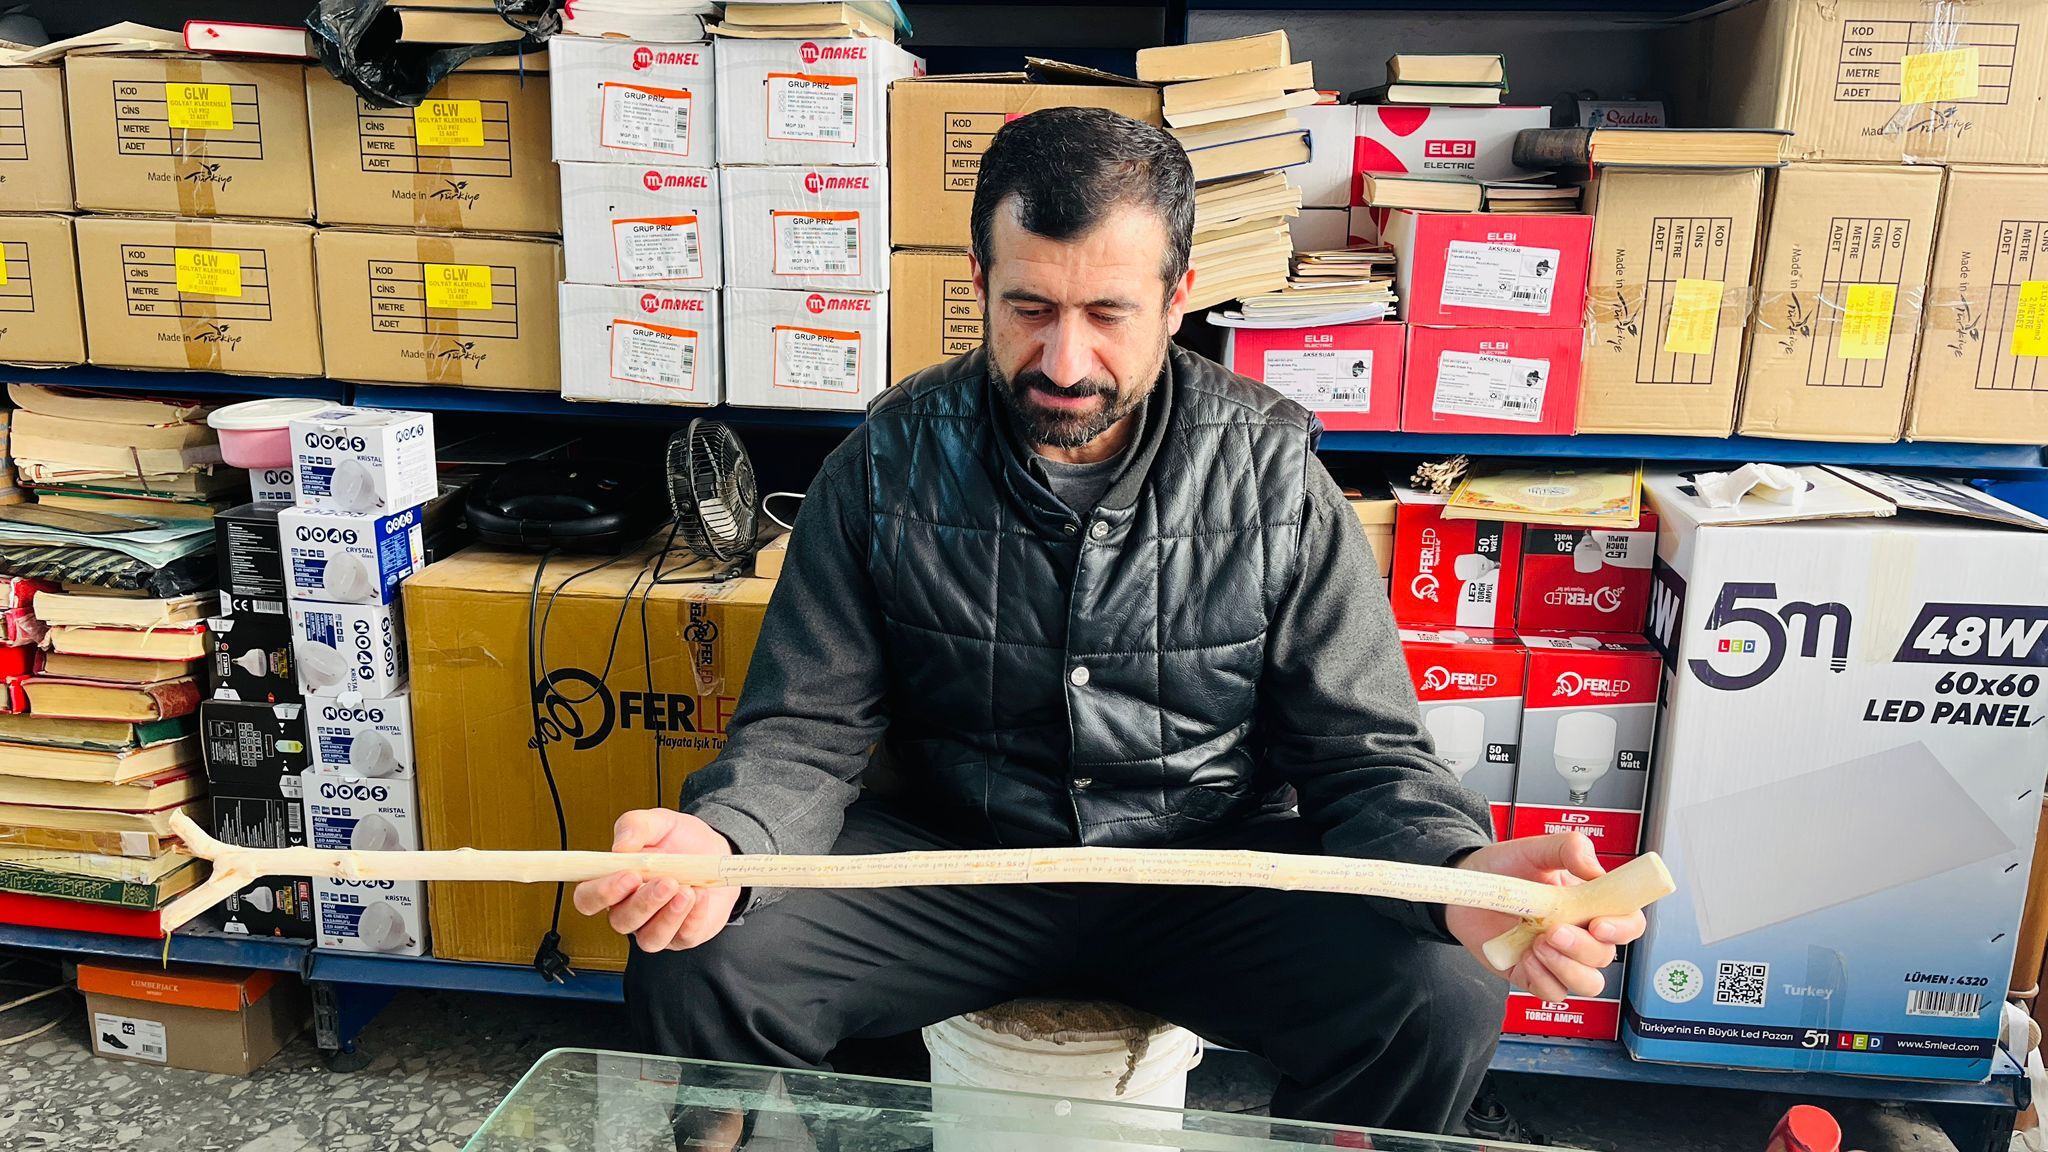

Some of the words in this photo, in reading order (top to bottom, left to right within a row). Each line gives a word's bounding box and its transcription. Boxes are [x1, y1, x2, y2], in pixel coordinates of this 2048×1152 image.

[1851, 26, 1874, 36] KOD
[821, 47, 867, 60] MAKEL
[1848, 47, 1873, 57] CİNS
[656, 52, 700, 66] MAKEL
[1845, 68, 1880, 78] METRE
[788, 81, 810, 89] GRUP
[812, 80, 829, 90] PRİZ
[120, 87, 138, 96] KOD
[184, 87, 209, 100] GLW
[624, 92, 647, 100] GRUP
[648, 93, 665, 102] PRİZ
[1843, 88, 1871, 97] ADET
[121, 105, 140, 115] CİNS
[433, 103, 459, 116] GLW
[952, 119, 972, 127] KOD
[1606, 110, 1658, 127] Sadaka
[123, 124, 150, 134] METRE
[365, 121, 385, 131] CİNS
[125, 142, 146, 151] ADET
[367, 141, 395, 150] METRE
[951, 138, 972, 148] CİNS
[1428, 142, 1472, 155] ELBI
[368, 159, 391, 168] ADET
[951, 159, 981, 168] METRE
[1424, 161, 1476, 170] ELECTRIC
[148, 172, 167, 182] Made
[169, 173, 181, 183] in
[184, 165, 232, 191] Türkiye
[664, 175, 708, 188] MAKEL
[825, 177, 870, 189] MAKEL
[951, 178, 975, 186] ADET
[392, 189, 416, 200] Made
[418, 190, 427, 200] in
[430, 182, 480, 210] Türkiye
[793, 217, 815, 225] GRUP
[816, 217, 833, 225] PRİZ
[633, 225, 654, 233] GRUP
[656, 223, 672, 232] PRİZ
[1487, 232, 1517, 241] ELBI
[1655, 225, 1665, 252] ADET
[1673, 225, 1685, 258] METRE
[1695, 225, 1705, 248] CİNS
[1714, 225, 1725, 247] KOD
[1832, 226, 1843, 252] ADET
[1871, 226, 1882, 249] CİNS
[1892, 227, 1903, 249] KOD
[2001, 228, 2013, 255] ADET
[1850, 226, 1862, 260] METRE
[2019, 228, 2032, 263] METRE
[128, 251, 146, 259] KOD
[1488, 246, 1521, 254] AKSESUAR
[193, 253, 218, 266] GLW
[1615, 248, 1626, 277] Made
[1791, 248, 1802, 276] Made
[1960, 251, 1971, 279] Made
[130, 269, 149, 278] CİNS
[375, 266, 393, 275] KOD
[443, 268, 469, 281] GLW
[376, 283, 396, 293] CİNS
[1615, 279, 1626, 289] in
[1790, 280, 1798, 289] in
[1959, 282, 1970, 292] in
[132, 287, 159, 296] METRE
[951, 286, 969, 295] KOD
[134, 303, 155, 312] ADET
[378, 302, 405, 312] METRE
[661, 299, 704, 312] MAKEL
[827, 299, 871, 311] MAKEL
[950, 306, 970, 315] CİNS
[379, 319, 400, 328] ADET
[950, 325, 979, 333] METRE
[157, 332, 181, 342] Made
[183, 333, 191, 343] in
[194, 326, 242, 351] Türkiye
[633, 329, 654, 337] GRUP
[656, 331, 672, 341] PRİZ
[794, 333, 816, 341] GRUP
[818, 334, 834, 343] PRİZ
[1304, 334, 1333, 343] ELBI
[950, 342, 972, 351] ADET
[1479, 341, 1509, 350] ELBI
[400, 349, 425, 359] Made
[427, 350, 435, 359] in
[438, 342, 487, 369] Türkiye
[1479, 356, 1511, 364] AKSESUAR
[305, 432, 366, 452] NOAS
[356, 455, 382, 463] KRİSTAL
[386, 511, 413, 534] NOAS
[296, 525, 358, 545] NOAS
[1554, 533, 1573, 541] watt
[1478, 538, 1490, 553] 50
[1490, 534, 1499, 552] watt
[1557, 541, 1573, 552] 50
[345, 546, 374, 554] CRYSTAL
[1419, 528, 1436, 573] FERLED
[1468, 582, 1477, 602] LED
[1477, 583, 1486, 602] TORCH
[1485, 583, 1493, 603] AMPUL
[1544, 592, 1593, 606] FERLED
[1913, 616, 2048, 659] 48W
[353, 620, 374, 680] NOAS
[381, 616, 394, 677] NOAS
[1718, 639, 1756, 653] LED
[1450, 672, 1497, 687] FERLED
[1583, 678, 1630, 693] FERLED
[1935, 672, 2039, 698] 60x60
[323, 706, 384, 722] NOAS
[620, 691, 735, 733] FERLE
[1864, 699, 1925, 722] LED
[1930, 702, 2032, 728] PANEL
[694, 737, 710, 750] Işık
[1489, 745, 1502, 754] 50
[1489, 753, 1509, 762] watt
[1620, 752, 1633, 760] 50
[1620, 760, 1640, 769] watt
[320, 782, 388, 801] NOAS
[1561, 813, 1590, 823] LED
[1544, 824, 1571, 834] TORCH
[131, 979, 179, 992] LUMBERJACK
[1904, 972, 1949, 984] LÜMEN
[1957, 976, 1988, 987] 4320
[1782, 984, 1834, 1000] Turkey
[1541, 1001, 1570, 1011] LED
[1525, 1011, 1552, 1021] TORCH
[1554, 1012, 1584, 1024] AMPUL
[123, 1024, 135, 1034] 42
[1640, 1021, 1692, 1034] Türkiye'nin
[1693, 1026, 1706, 1035] En
[1708, 1028, 1739, 1040] Büyük
[1741, 1030, 1760, 1039] Led
[1762, 1031, 1794, 1041] Pazarı
[1801, 1029, 1829, 1048] 5m
[1840, 1035, 1881, 1048] LED
[1897, 1040, 1980, 1051] www.5mled.com
